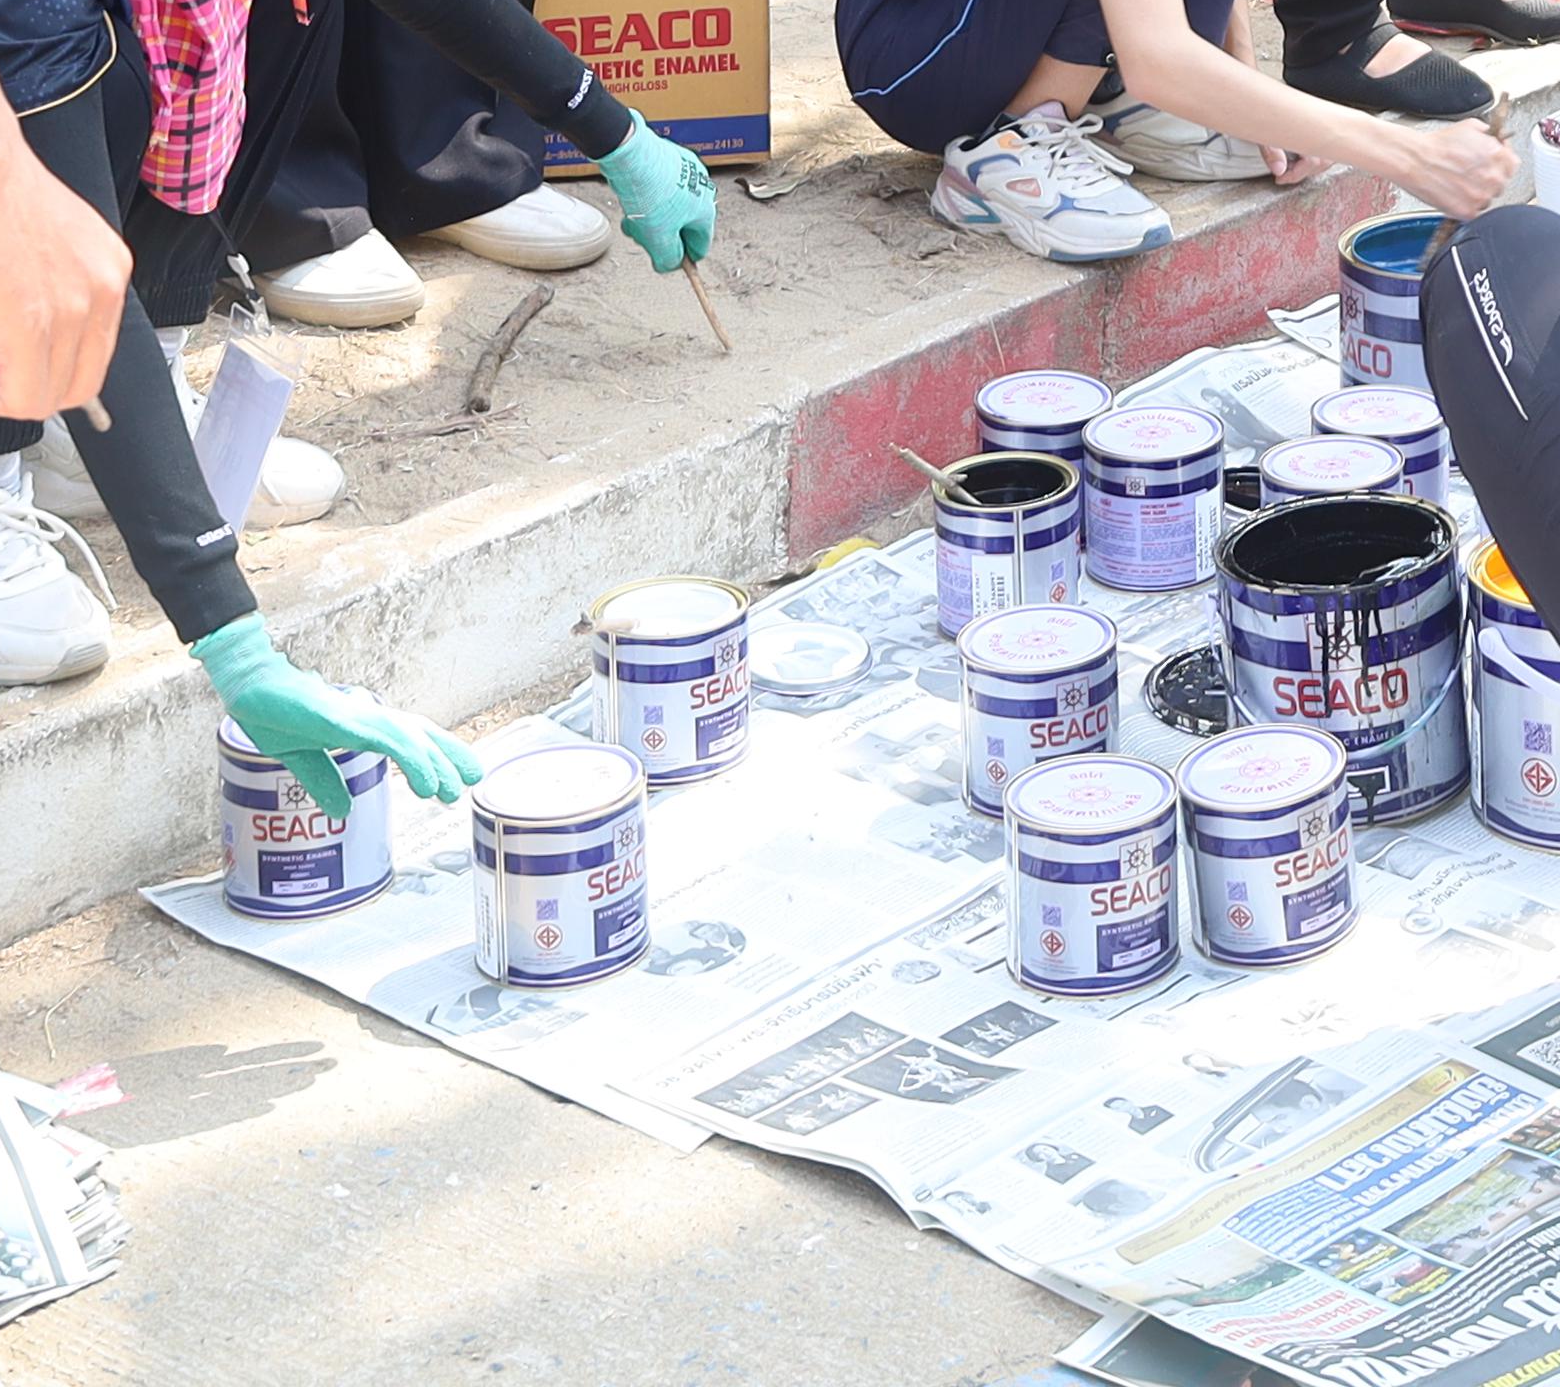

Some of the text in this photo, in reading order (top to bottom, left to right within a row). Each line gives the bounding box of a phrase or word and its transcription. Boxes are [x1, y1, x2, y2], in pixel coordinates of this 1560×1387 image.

[541, 7, 732, 57] SEACO
[633, 80, 669, 93] GLOSS
[655, 52, 740, 77] ENAMEL
[1273, 667, 1409, 719] SEACO
[1029, 704, 1110, 749] SEACO
[252, 812, 347, 843] SEACO
[1273, 827, 1349, 889] SEACO
[1090, 865, 1172, 917] SEACO
